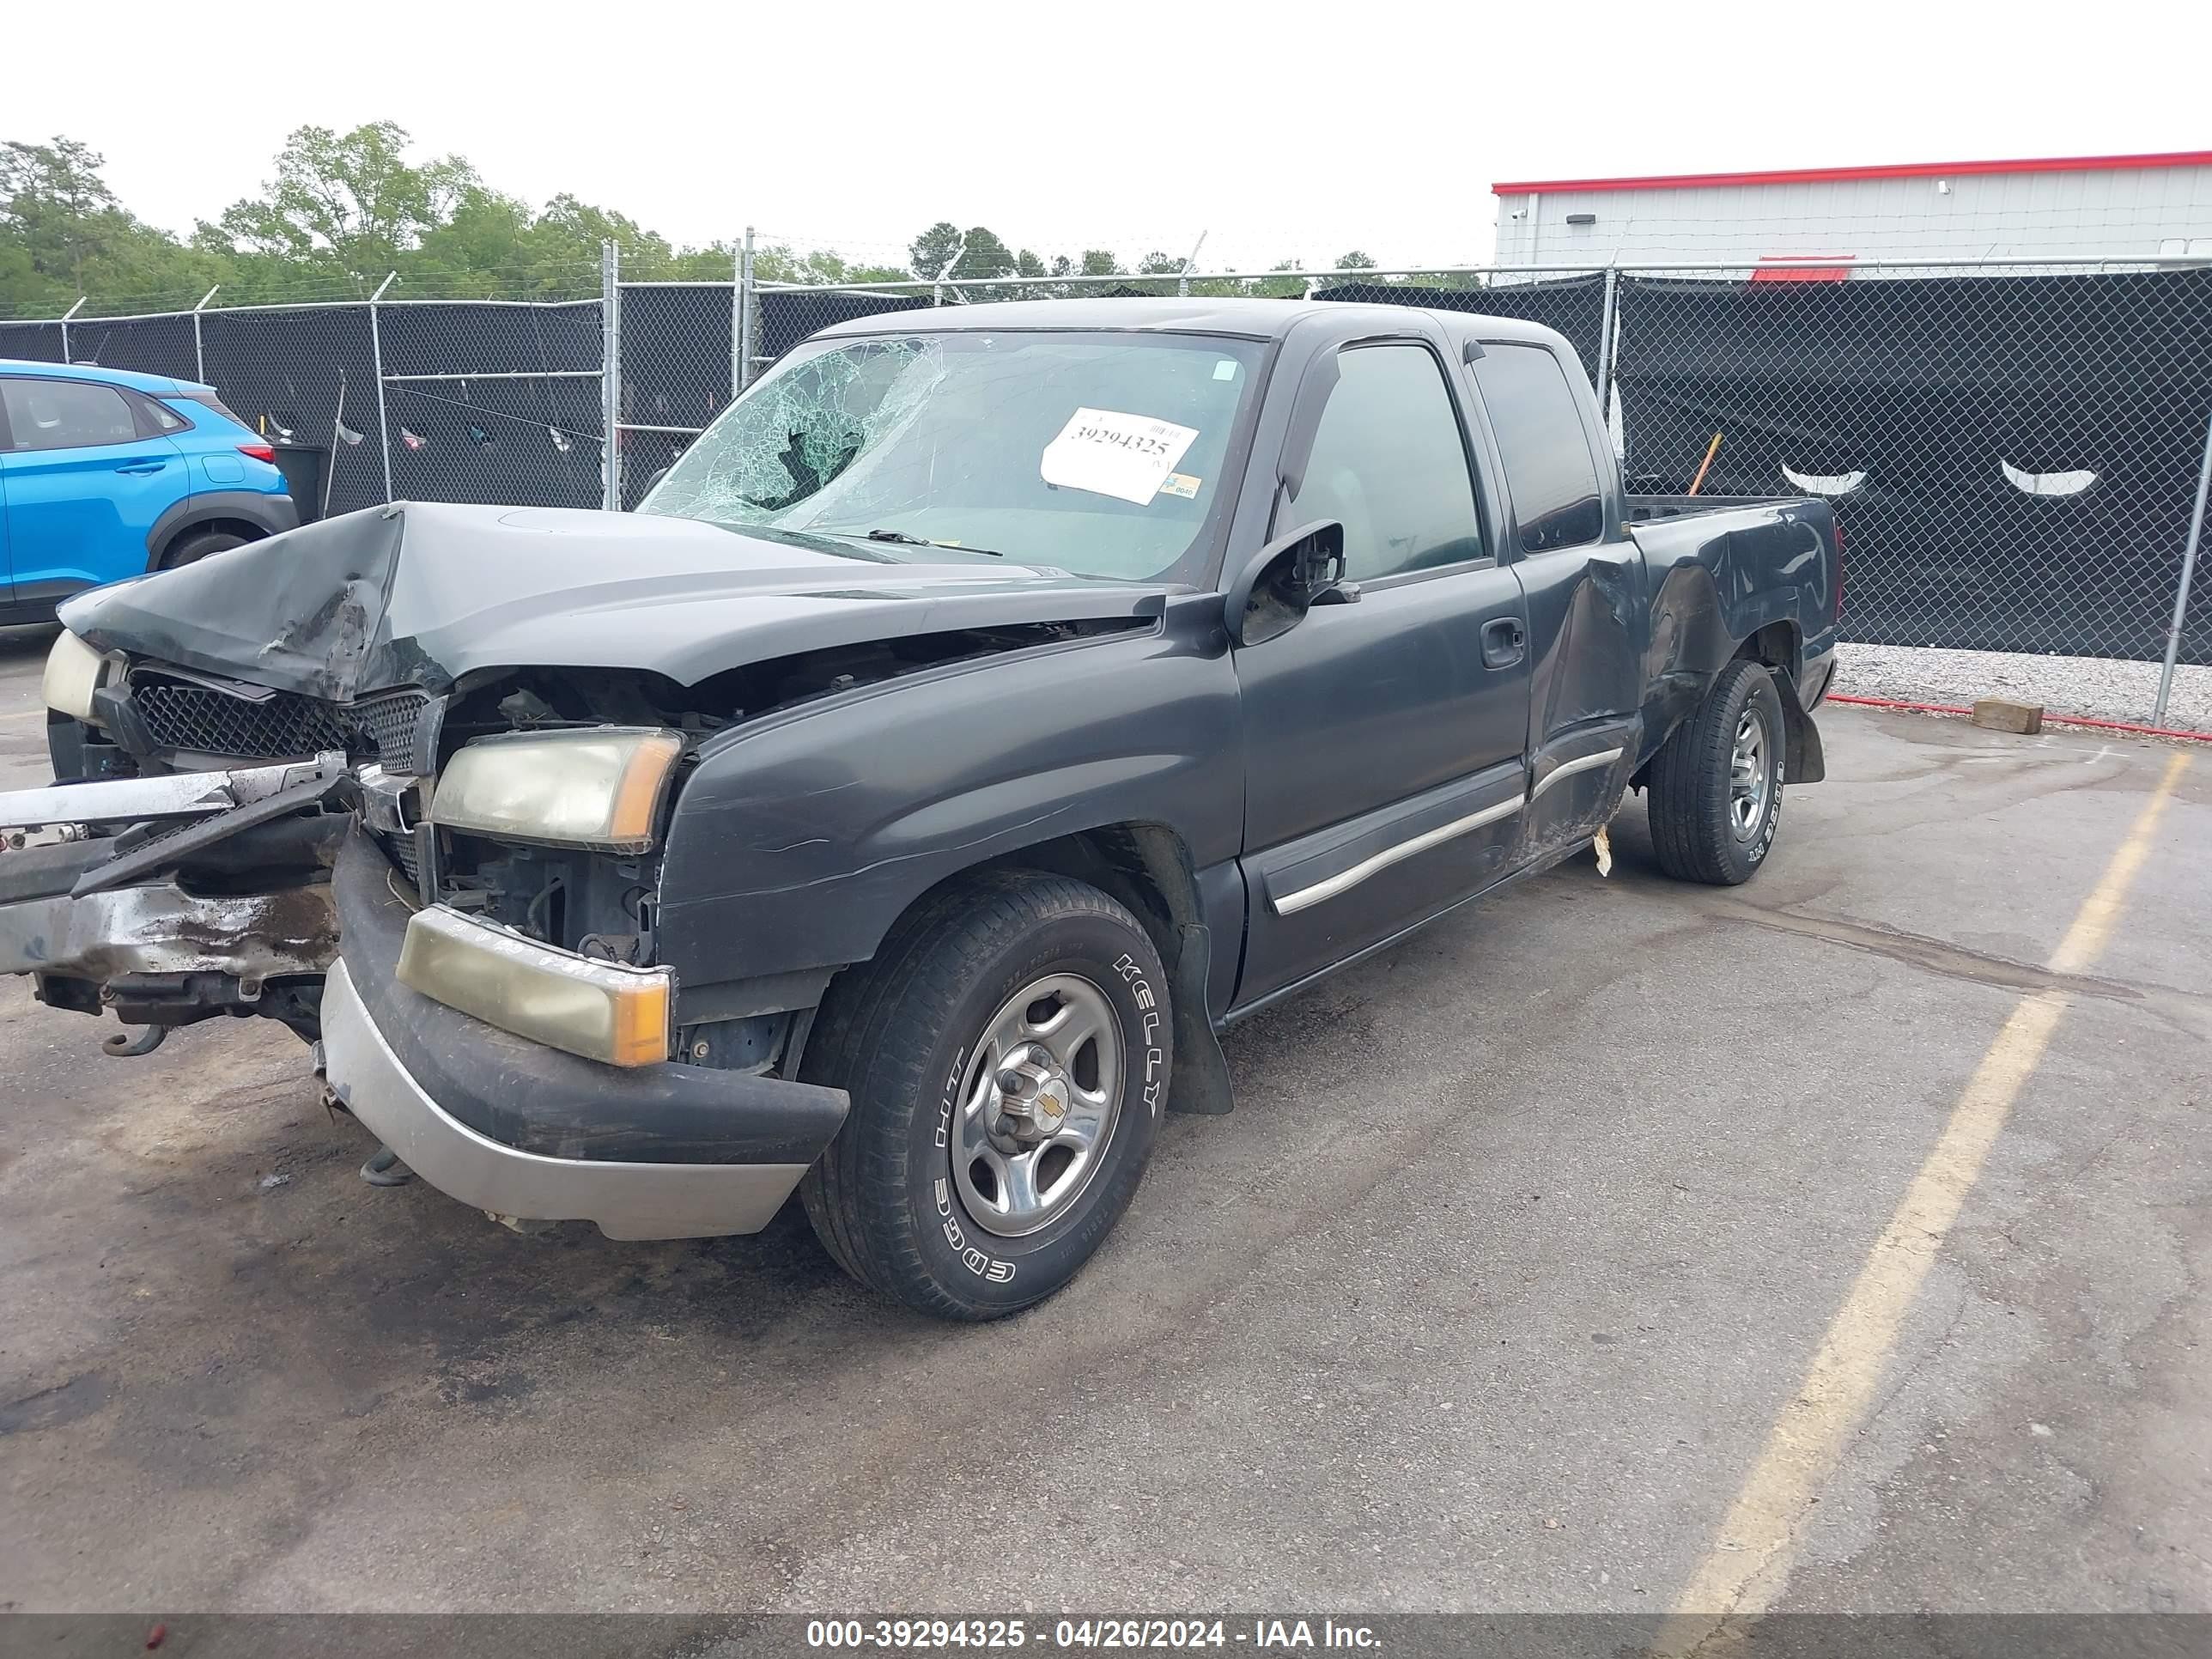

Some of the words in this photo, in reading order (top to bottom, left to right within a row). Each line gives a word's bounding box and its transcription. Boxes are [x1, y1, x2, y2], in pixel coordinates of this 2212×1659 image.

[1071, 426, 1170, 455] 39294325
[1765, 761, 1785, 843] EDGE
[1747, 842, 1765, 862] HT
[1112, 952, 1164, 1120] KELLY
[934, 1045, 965, 1148] HT
[934, 1177, 1017, 1284] EDGE
